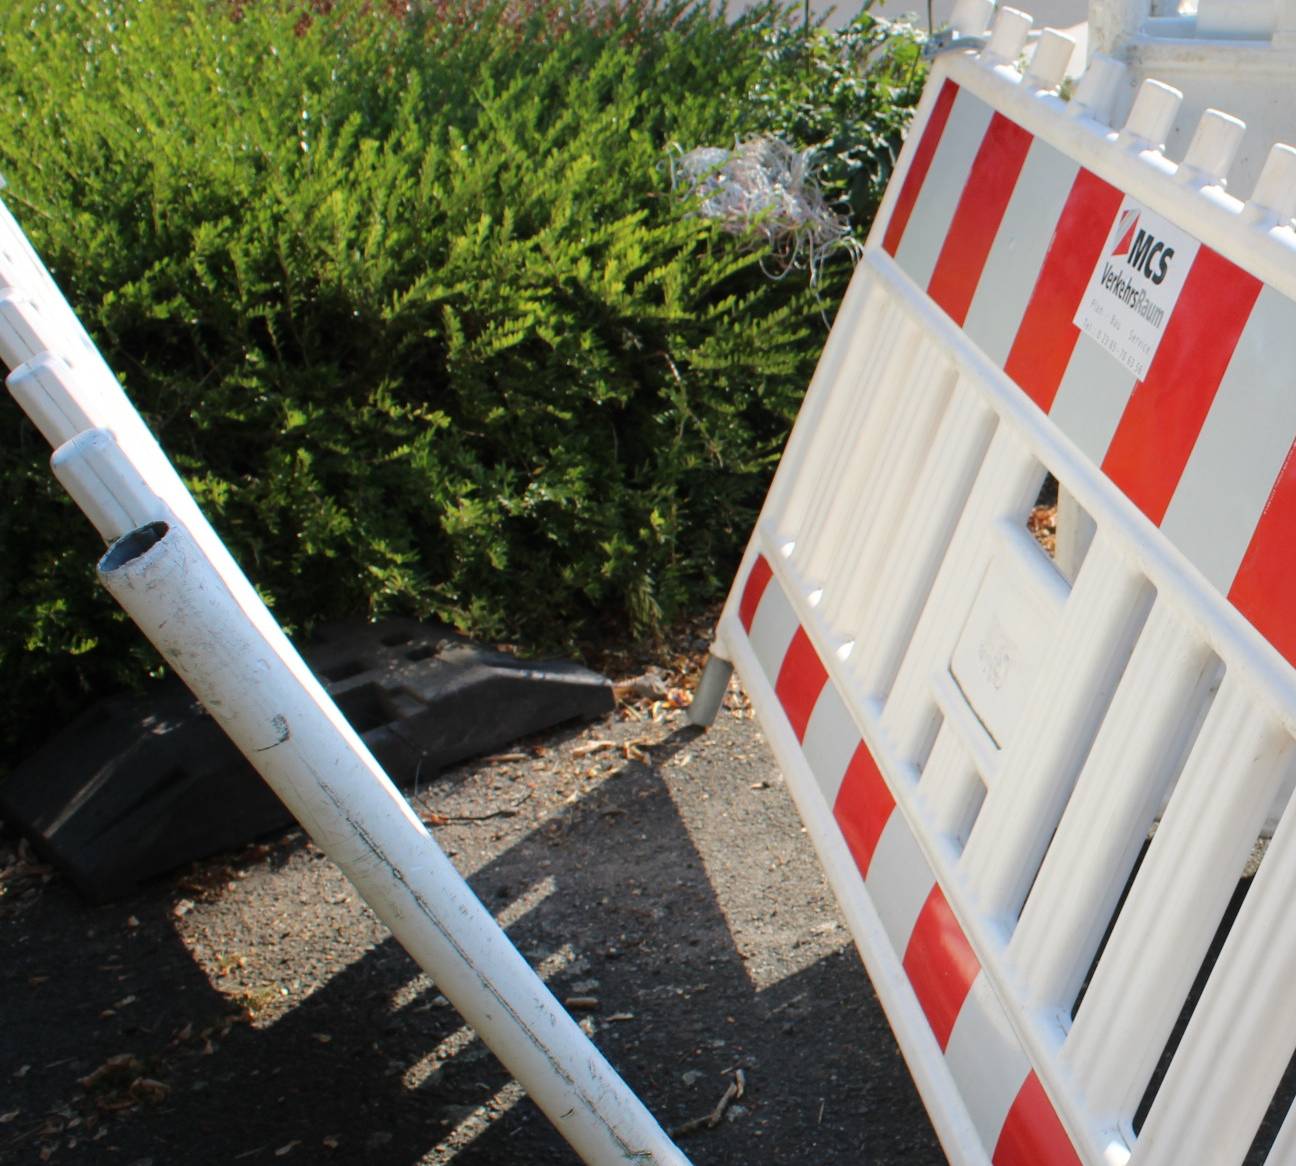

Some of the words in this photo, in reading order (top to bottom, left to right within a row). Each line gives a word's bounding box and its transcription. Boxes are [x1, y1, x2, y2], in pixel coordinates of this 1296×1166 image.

[1127, 228, 1175, 286] MCS
[1100, 262, 1165, 330] VerkehrsRaum
[1128, 329, 1152, 355] Service
